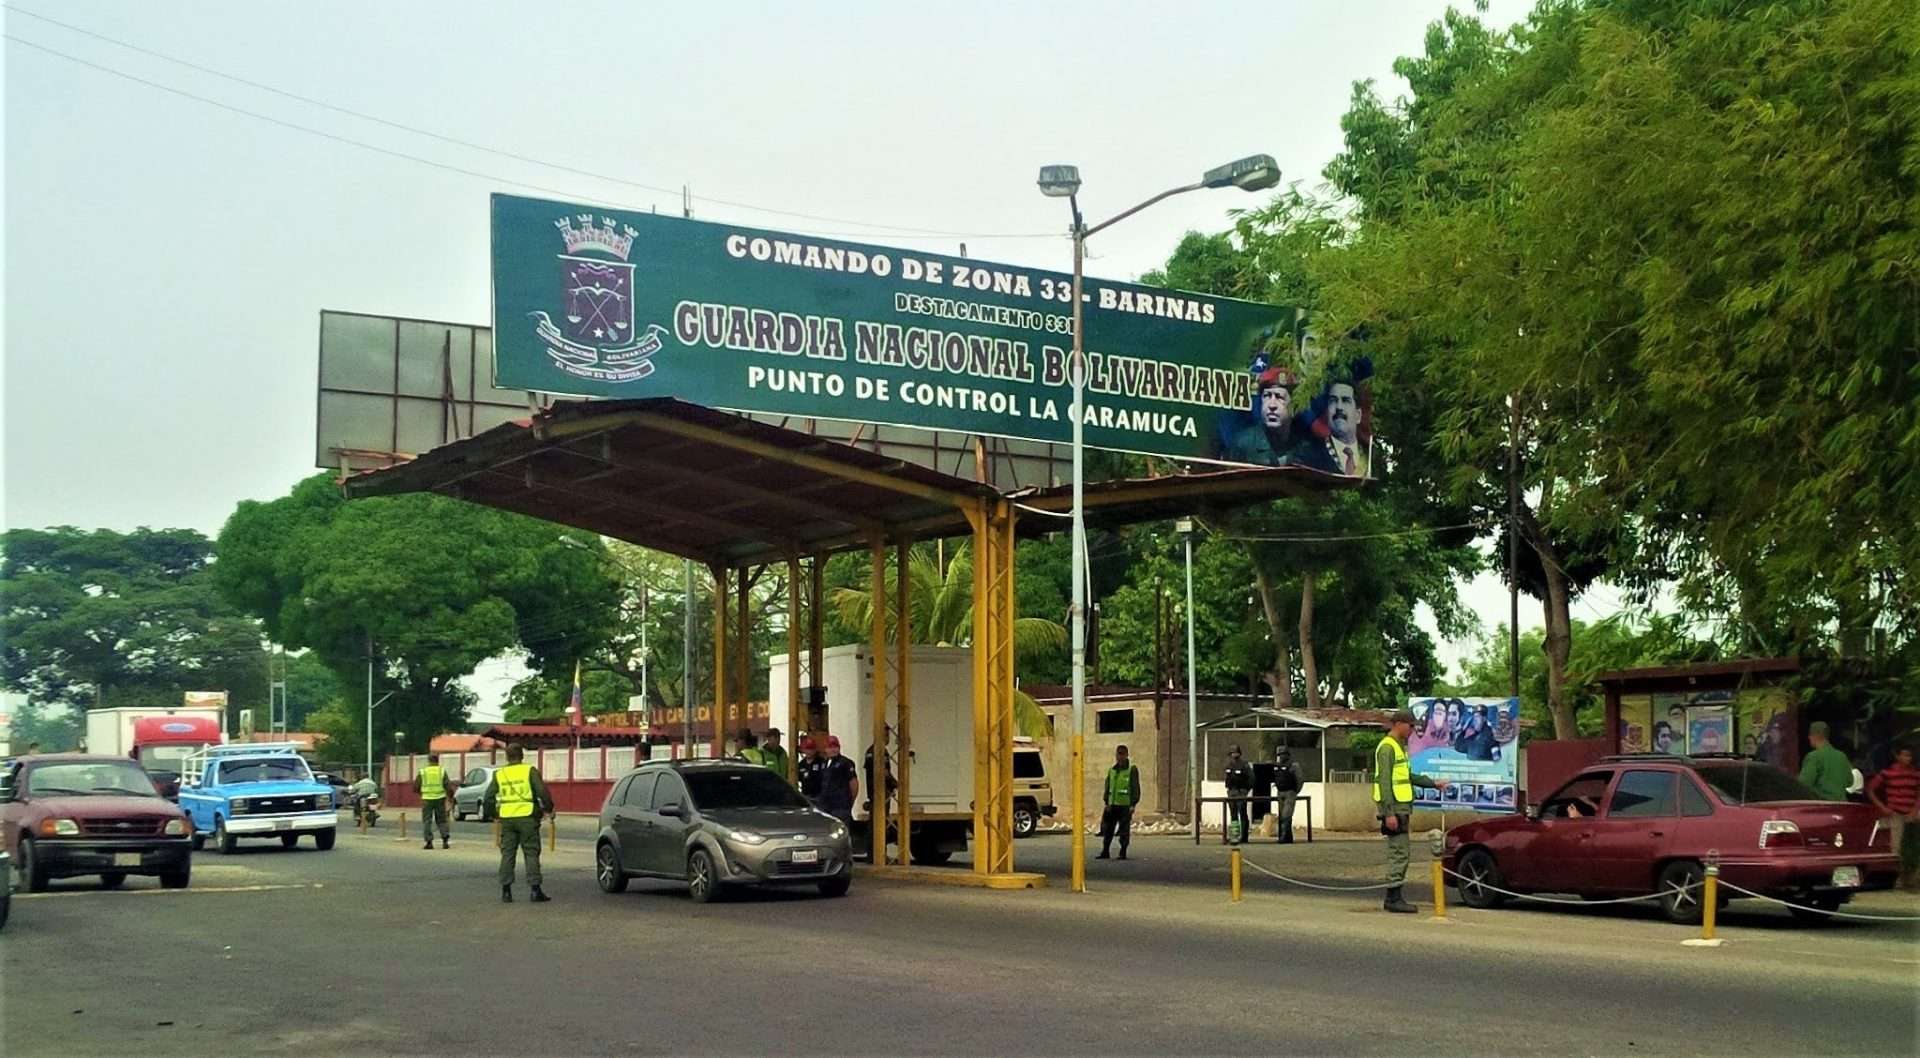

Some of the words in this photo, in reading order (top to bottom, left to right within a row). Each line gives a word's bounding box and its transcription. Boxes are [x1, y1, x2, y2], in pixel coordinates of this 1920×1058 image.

[726, 234, 891, 276] COMANDO
[902, 258, 943, 284] DE
[952, 265, 1031, 297] ZONA
[1040, 278, 1072, 303] 33
[1099, 288, 1215, 324] BARINAS
[895, 292, 1043, 330] DESTACAMENTO
[674, 300, 847, 361] GUARDIA
[855, 320, 1035, 383] NACIONAL
[1042, 345, 1253, 411] BOLIVARIANA
[748, 365, 844, 397] PUNTO
[855, 376, 889, 401] DE
[900, 381, 1021, 416] CONTROL
[1029, 397, 1058, 421] LA
